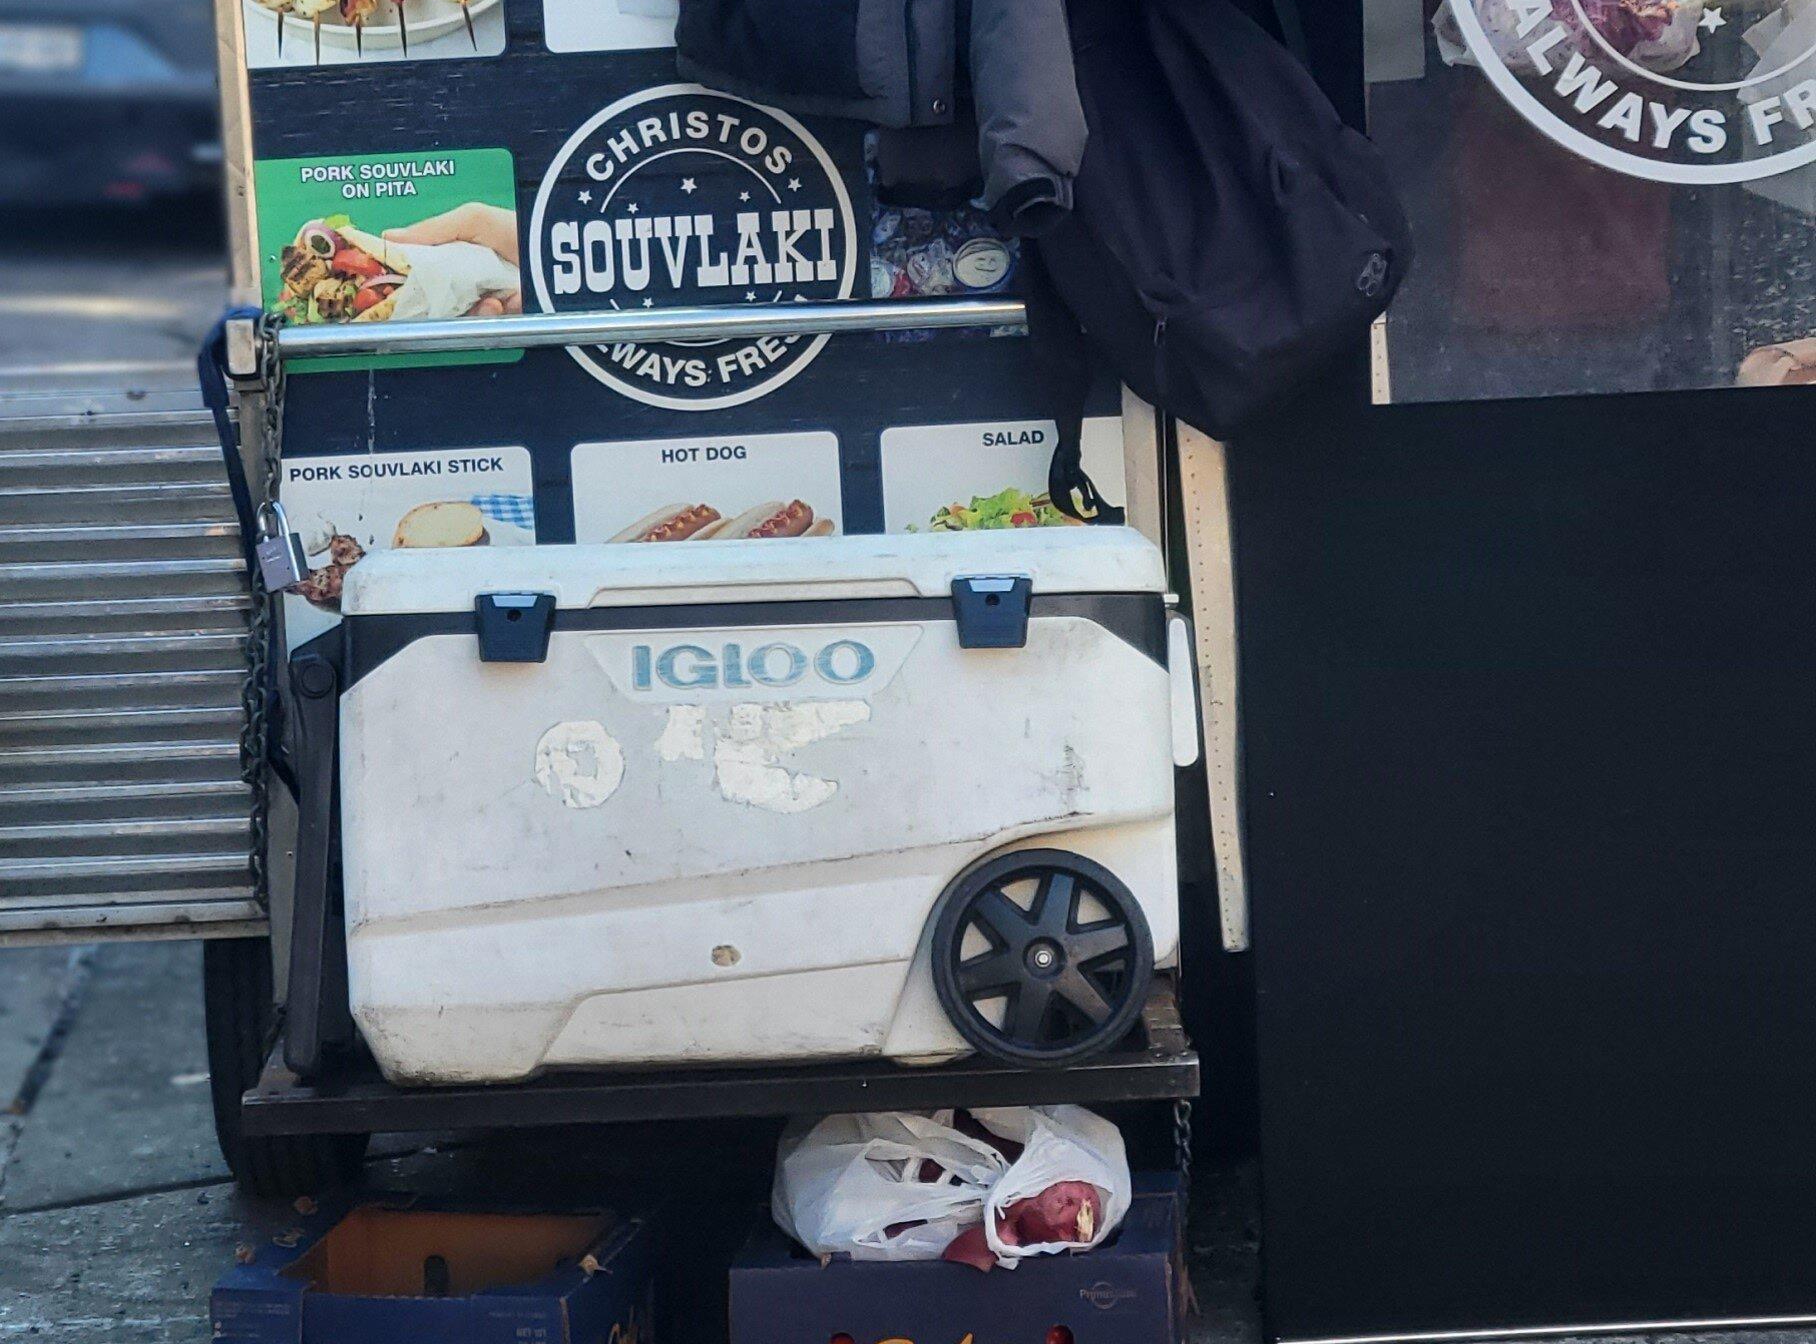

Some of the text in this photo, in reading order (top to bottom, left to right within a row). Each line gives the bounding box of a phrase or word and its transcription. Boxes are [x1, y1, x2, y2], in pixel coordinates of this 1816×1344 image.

[585, 109, 793, 182] CHRISTOS
[301, 160, 455, 182] PORK SOUVLAKI
[342, 181, 417, 198] ON PITA
[551, 207, 837, 296] SOUVLAKI
[597, 332, 802, 387] WAYS FRE
[982, 430, 1044, 446] SALAD
[661, 445, 747, 463] HOT DOG
[290, 457, 504, 481] PORK SOUVLAKI STICK
[631, 638, 876, 691] IGLOO
